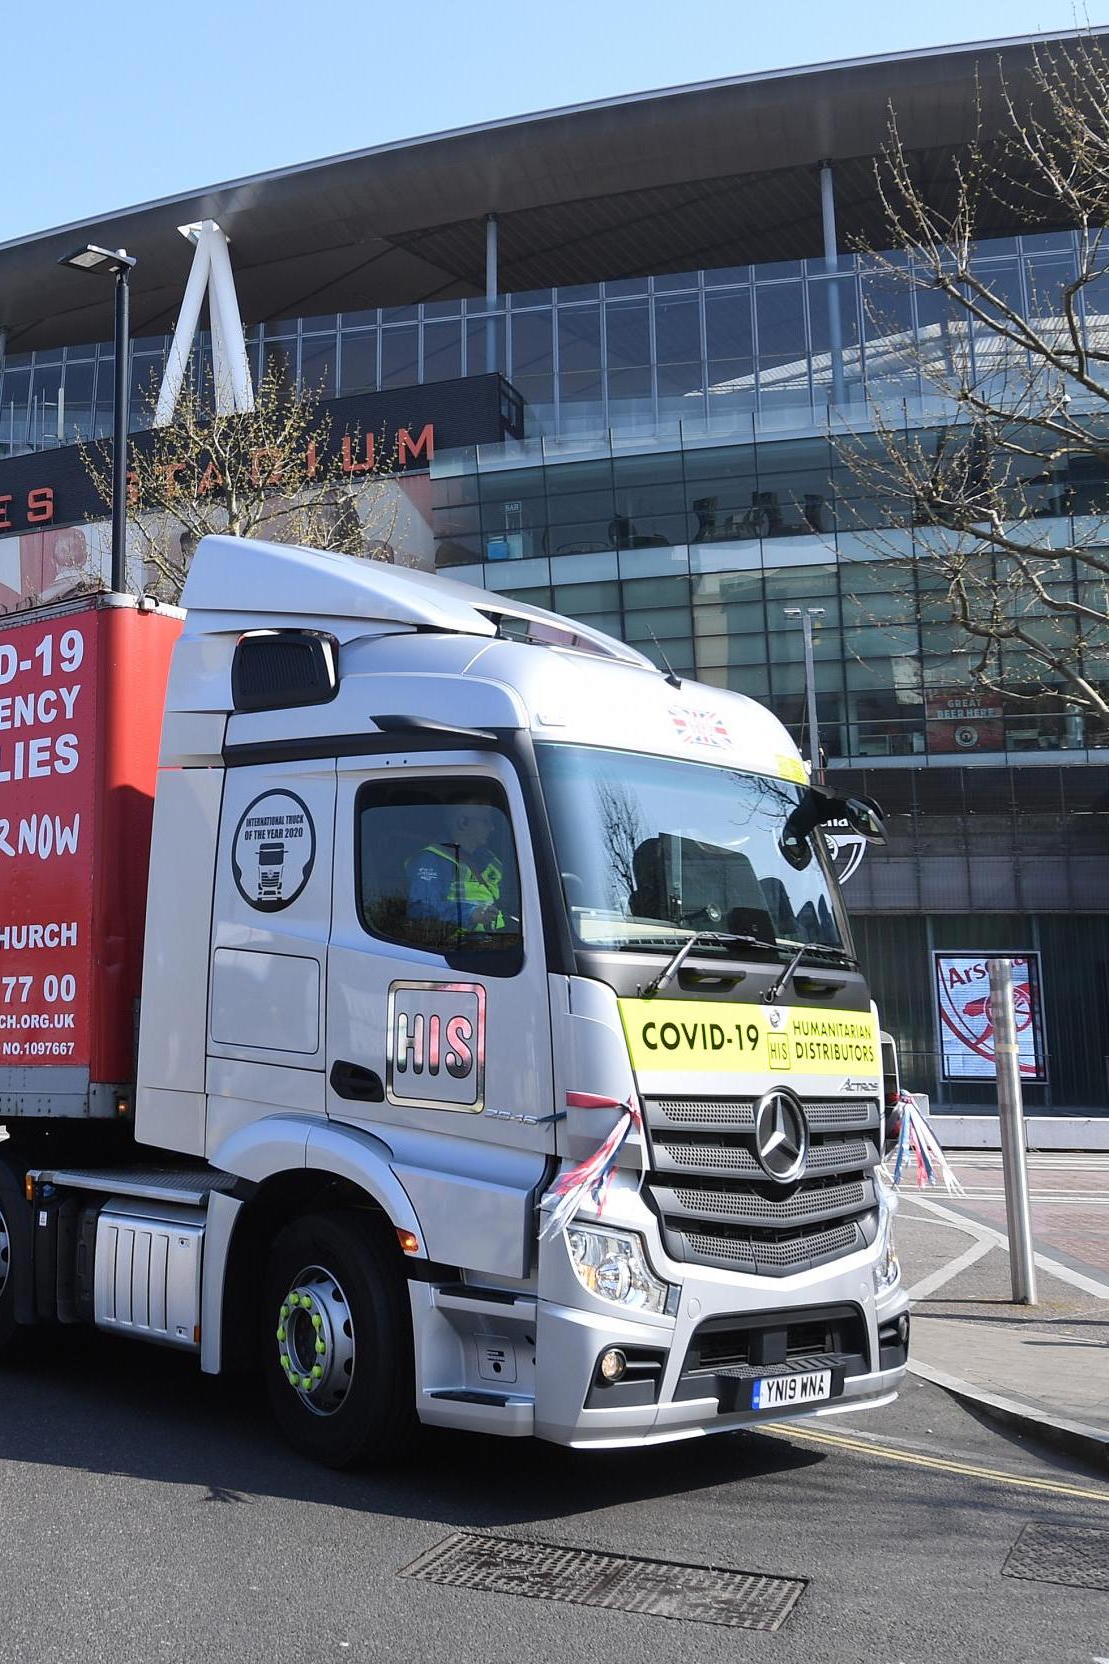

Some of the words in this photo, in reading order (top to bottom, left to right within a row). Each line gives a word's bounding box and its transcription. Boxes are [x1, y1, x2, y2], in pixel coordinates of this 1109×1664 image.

[946, 698, 982, 708] GREAT
[937, 708, 964, 719] BEER
[246, 815, 284, 828] INTERNATIONAL
[286, 814, 304, 825] TRUCK
[244, 830, 253, 841] OF
[254, 829, 266, 840] THE
[267, 828, 284, 839] YEAR
[284, 826, 303, 839] 2020
[1, 975, 34, 1003] 77
[43, 974, 76, 1002] 00
[641, 1021, 760, 1051] COVID-19
[793, 1020, 873, 1041] HUMANITARIAN
[2, 1042, 75, 1055] NO.1097667
[396, 1012, 473, 1079] HIS
[770, 1043, 789, 1061] HIS
[795, 1041, 875, 1063] DISTRIBUTORS
[766, 1378, 797, 1403] YN19
[800, 1374, 825, 1399] WNA
